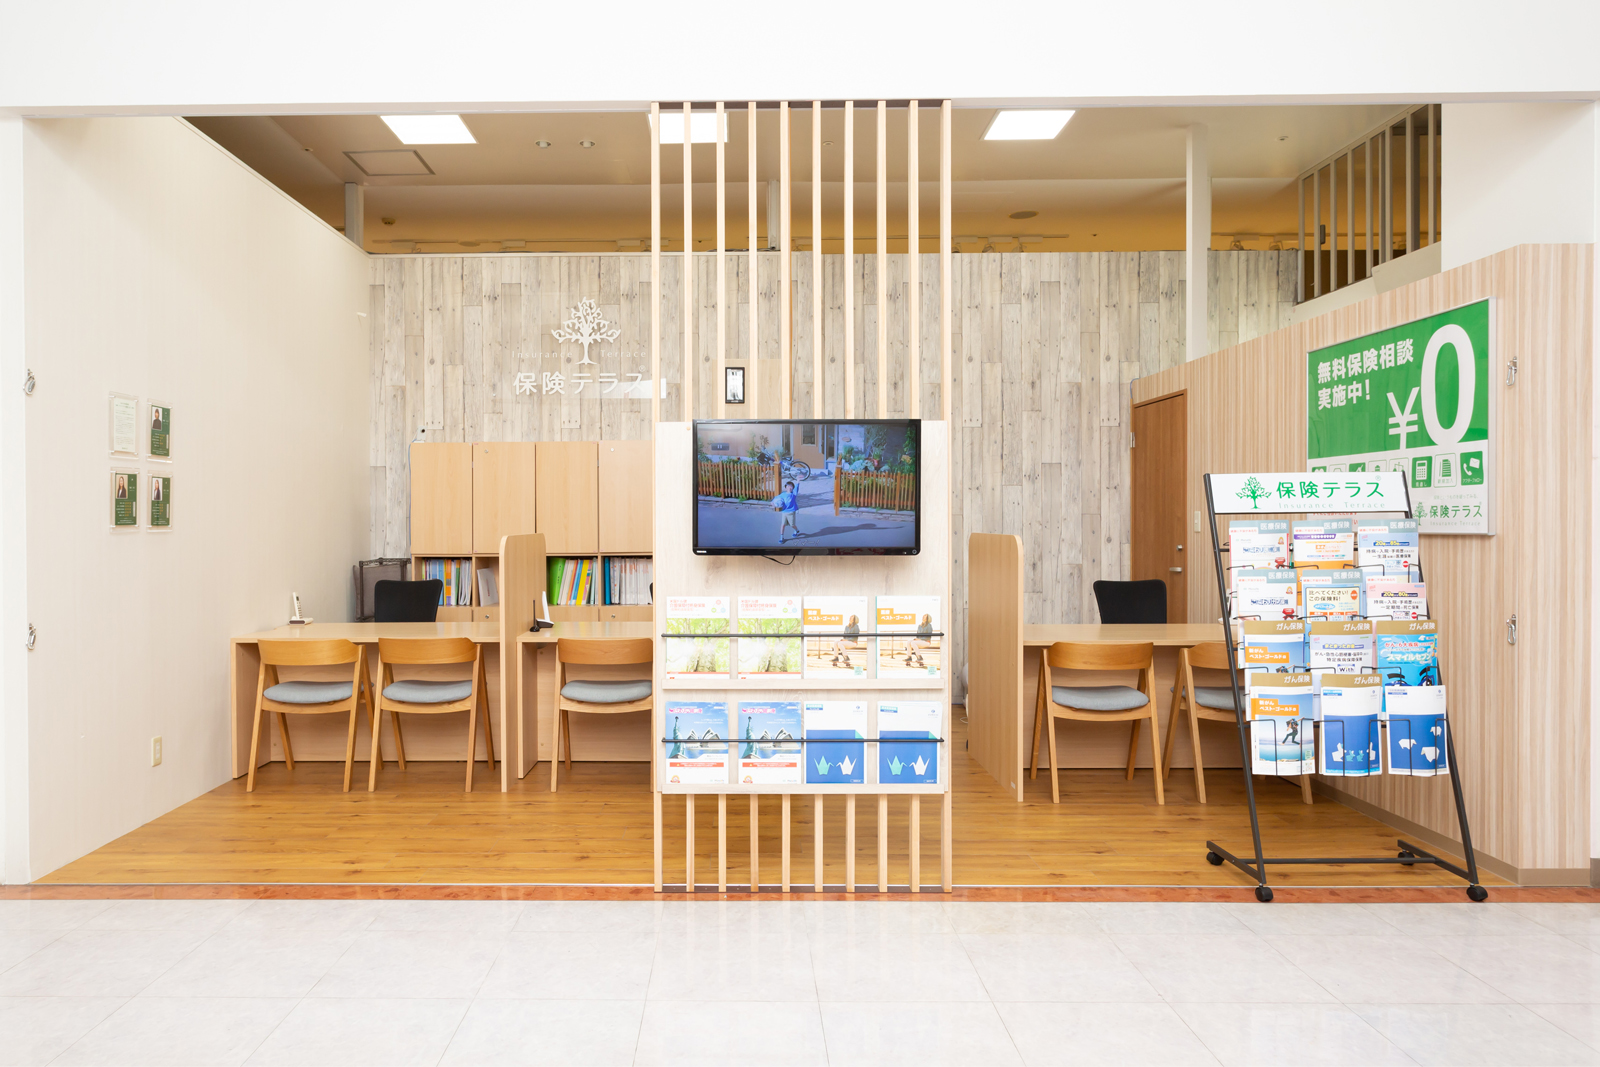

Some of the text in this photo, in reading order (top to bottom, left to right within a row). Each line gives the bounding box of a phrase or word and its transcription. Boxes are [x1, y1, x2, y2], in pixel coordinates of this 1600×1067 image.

[512, 350, 646, 358] Insurance Terrace
[1317, 338, 1414, 384] 無料保険相談
[513, 371, 643, 396] 保険テラス
[1276, 480, 1385, 499] 保険テラス
[1429, 504, 1483, 519] 保険テラス
[1276, 622, 1303, 631] がん保険
[1343, 622, 1371, 631] がん保険
[1409, 622, 1436, 631] がん保険
[1284, 675, 1311, 684] がん保険
[1354, 676, 1381, 685] がん保険
